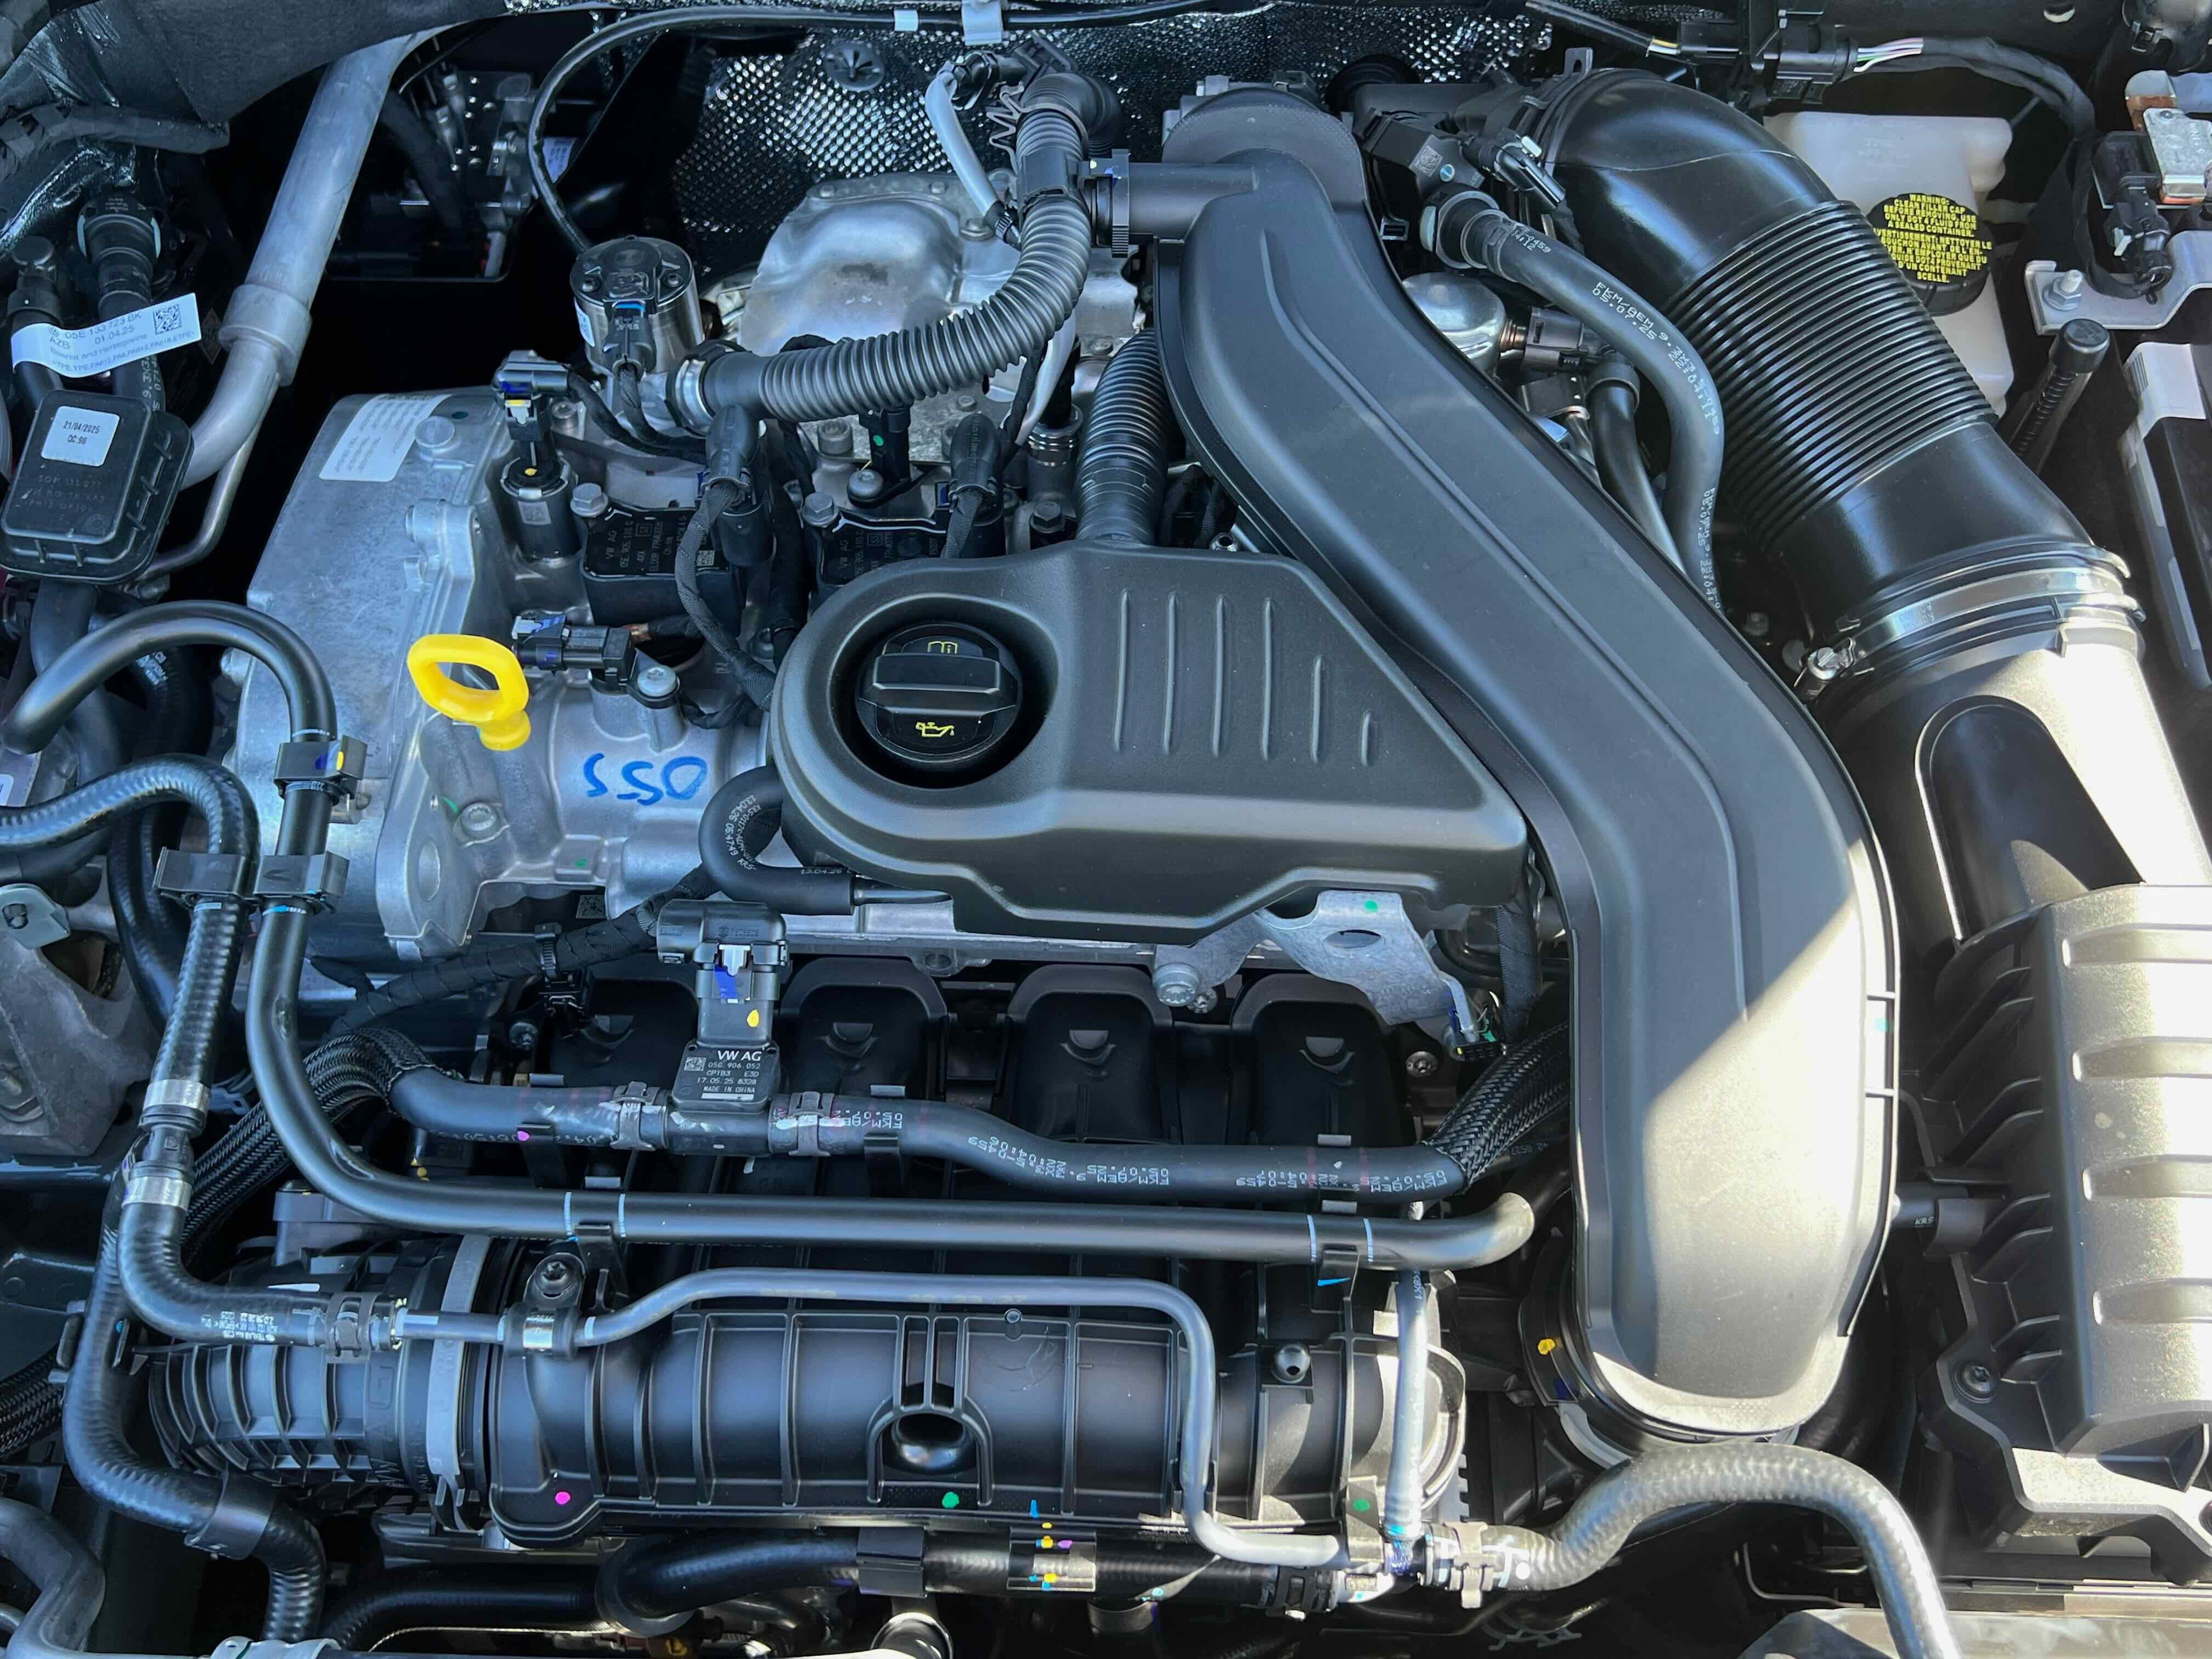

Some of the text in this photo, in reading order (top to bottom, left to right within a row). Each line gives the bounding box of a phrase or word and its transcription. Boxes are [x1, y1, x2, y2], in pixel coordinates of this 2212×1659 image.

[1910, 194, 1949, 205] WARNING:
[1894, 199, 1965, 215] CLEAN FILLER CAP
[1884, 205, 1915, 216] BEFORE
[1961, 215, 1976, 223] USE
[1884, 213, 1906, 221] ONLY
[1930, 218, 1954, 228] FLUID
[1955, 221, 1977, 230] FROM
[1894, 221, 1925, 232] SEALED
[1921, 241, 1947, 252] AVANT
[1939, 236, 1980, 247] NETTOYER
[1981, 241, 1993, 250] LE
[1936, 258, 1981, 270] PROVENANT
[1958, 253, 1974, 262] QUE
[1976, 256, 1987, 264] DU
[1919, 263, 1967, 276] CONTENANT
[718, 1050, 762, 1062] VW AG
